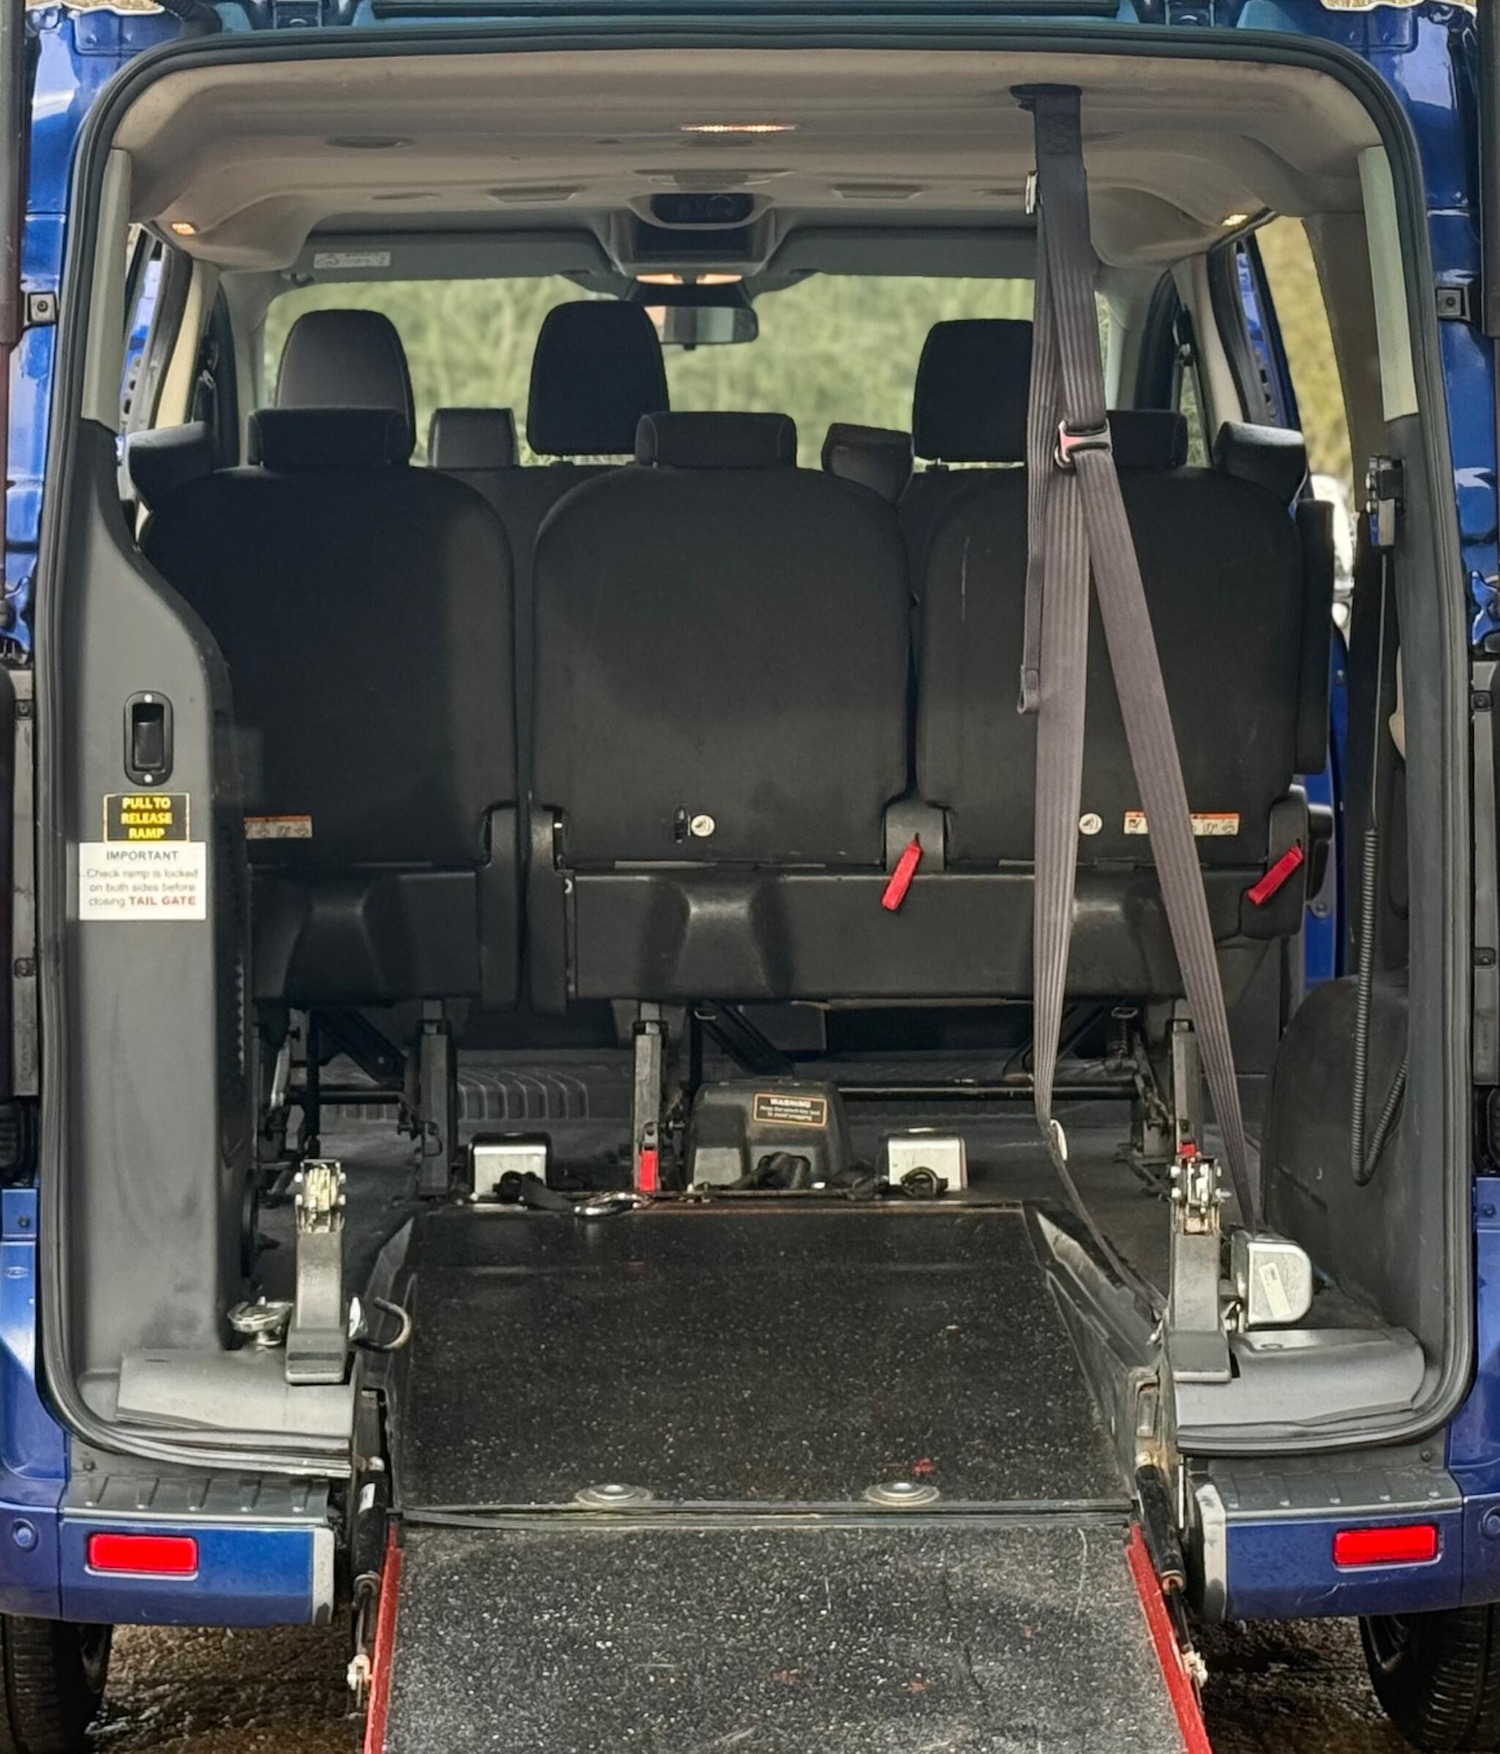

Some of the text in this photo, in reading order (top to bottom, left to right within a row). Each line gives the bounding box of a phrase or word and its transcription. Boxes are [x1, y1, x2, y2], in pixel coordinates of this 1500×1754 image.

[122, 797, 171, 809] PULL TO
[120, 812, 173, 824] RELEASE
[128, 828, 165, 839] RAMP
[106, 850, 178, 861] IMPORTANT
[86, 868, 198, 880] Check ramp is locked
[89, 881, 196, 892] on both sides before
[88, 896, 196, 908] closing TAIL GATE
